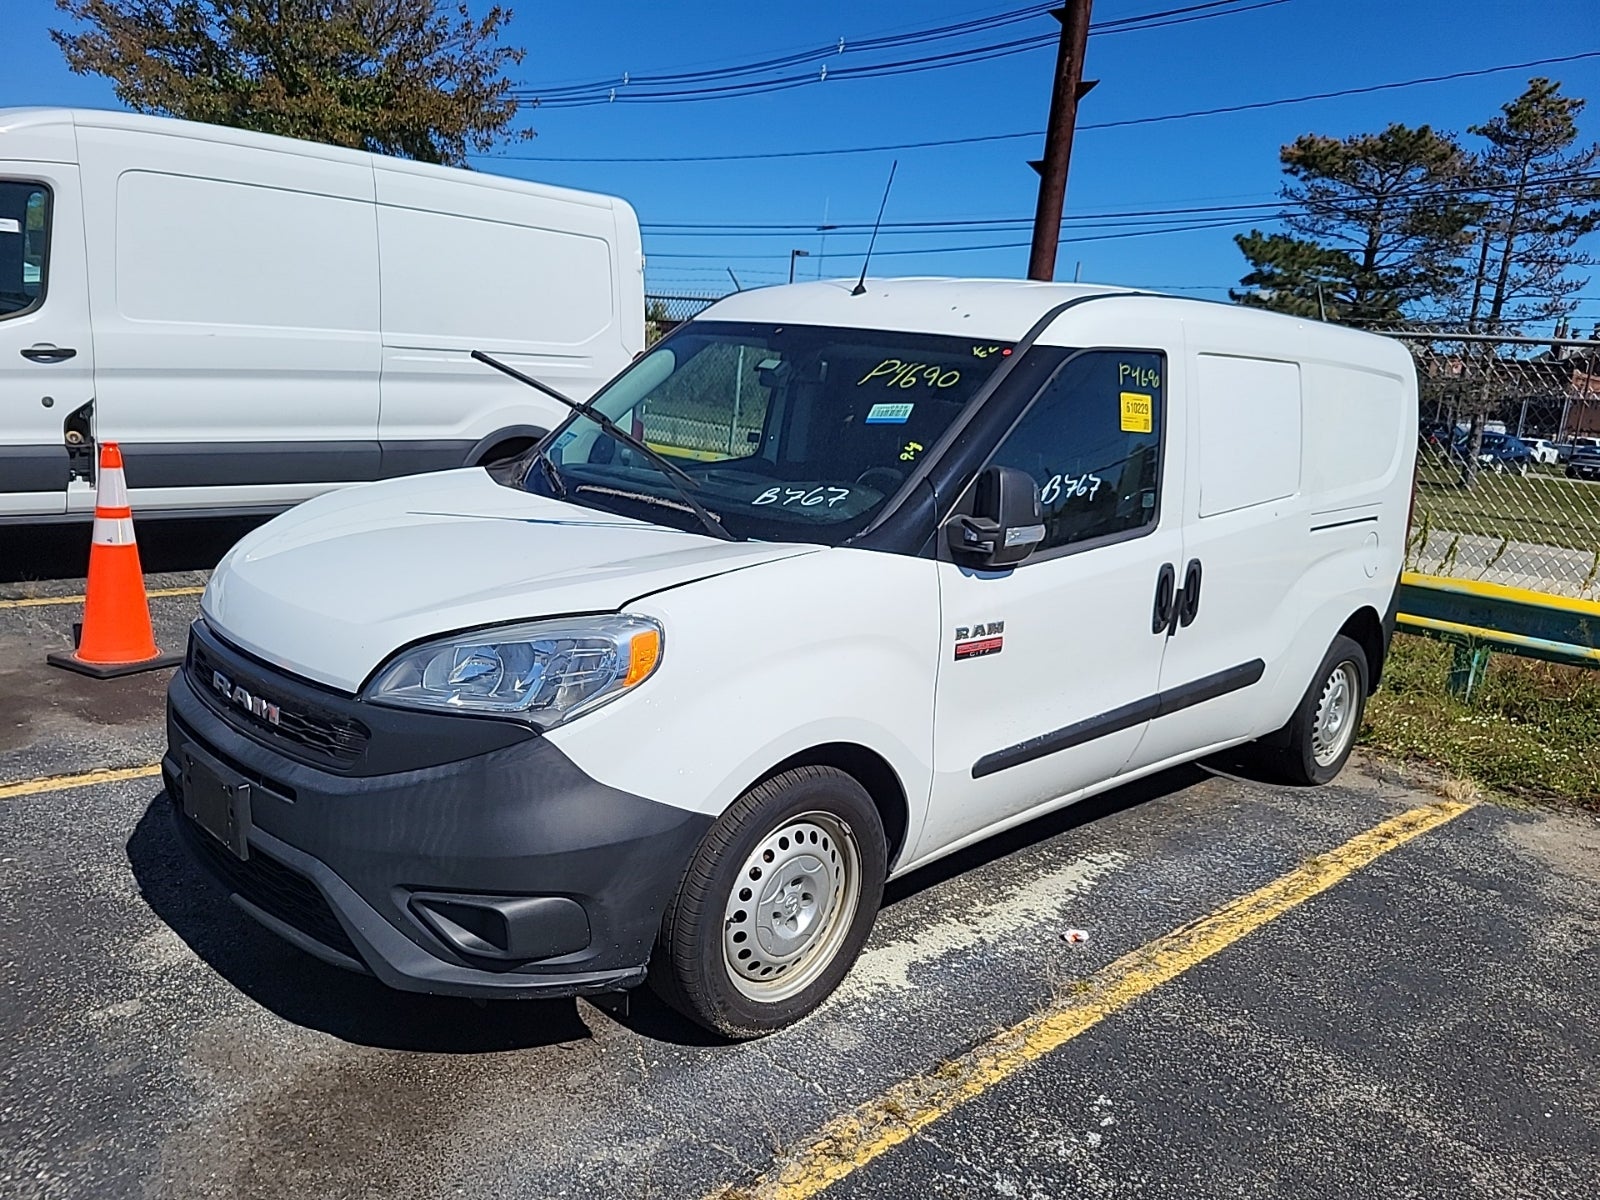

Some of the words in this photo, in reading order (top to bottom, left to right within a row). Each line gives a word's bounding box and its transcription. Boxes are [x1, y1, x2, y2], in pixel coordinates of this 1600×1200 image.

[751, 486, 850, 508] B767
[1040, 474, 1101, 504] B767
[954, 620, 1005, 641] RAM
[212, 670, 280, 725] RAM
